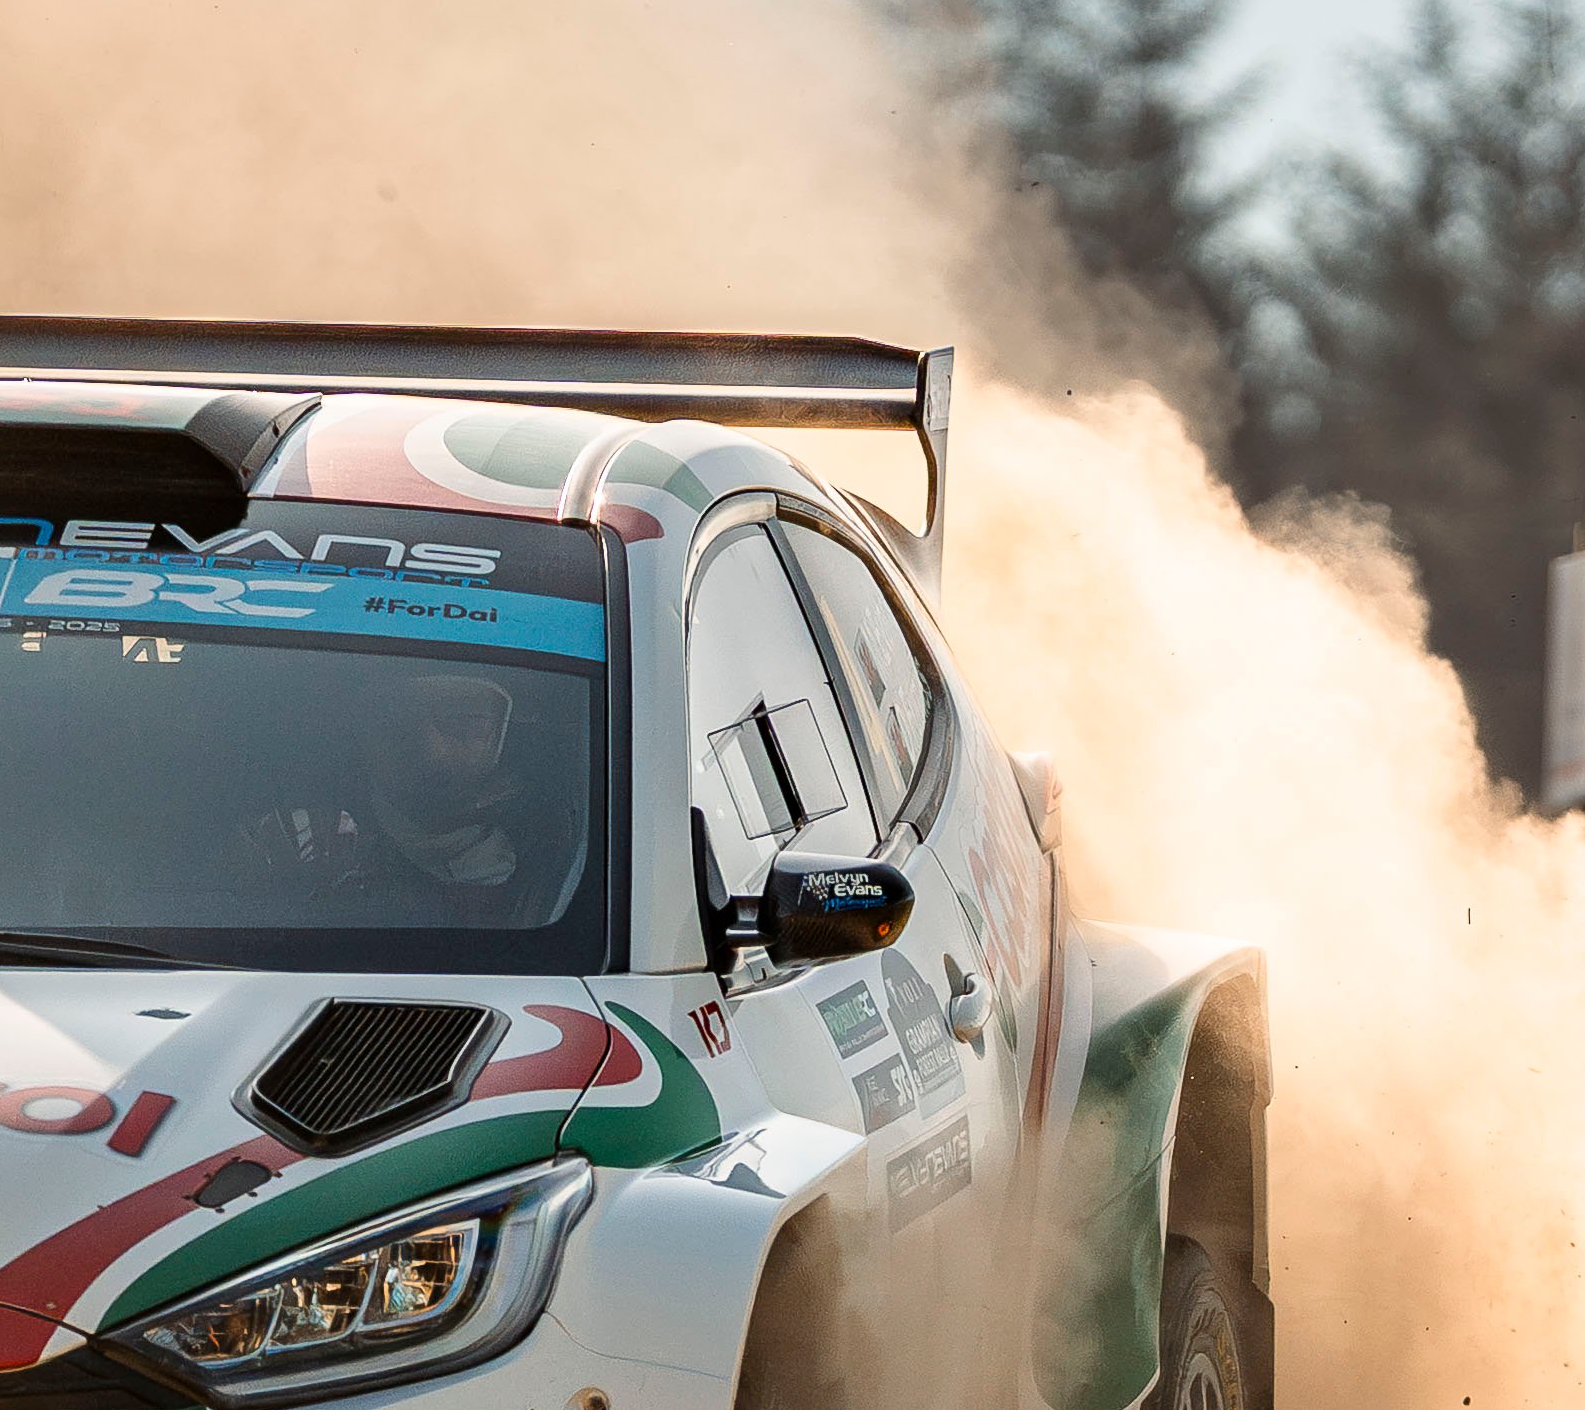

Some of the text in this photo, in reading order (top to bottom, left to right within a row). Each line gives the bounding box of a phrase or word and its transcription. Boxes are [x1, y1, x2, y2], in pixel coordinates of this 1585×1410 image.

[24, 568, 335, 618] BRC
[363, 596, 498, 623] #ForDai
[48, 619, 121, 632] 2025
[809, 872, 869, 887] Melvyn
[834, 883, 883, 897] Evans
